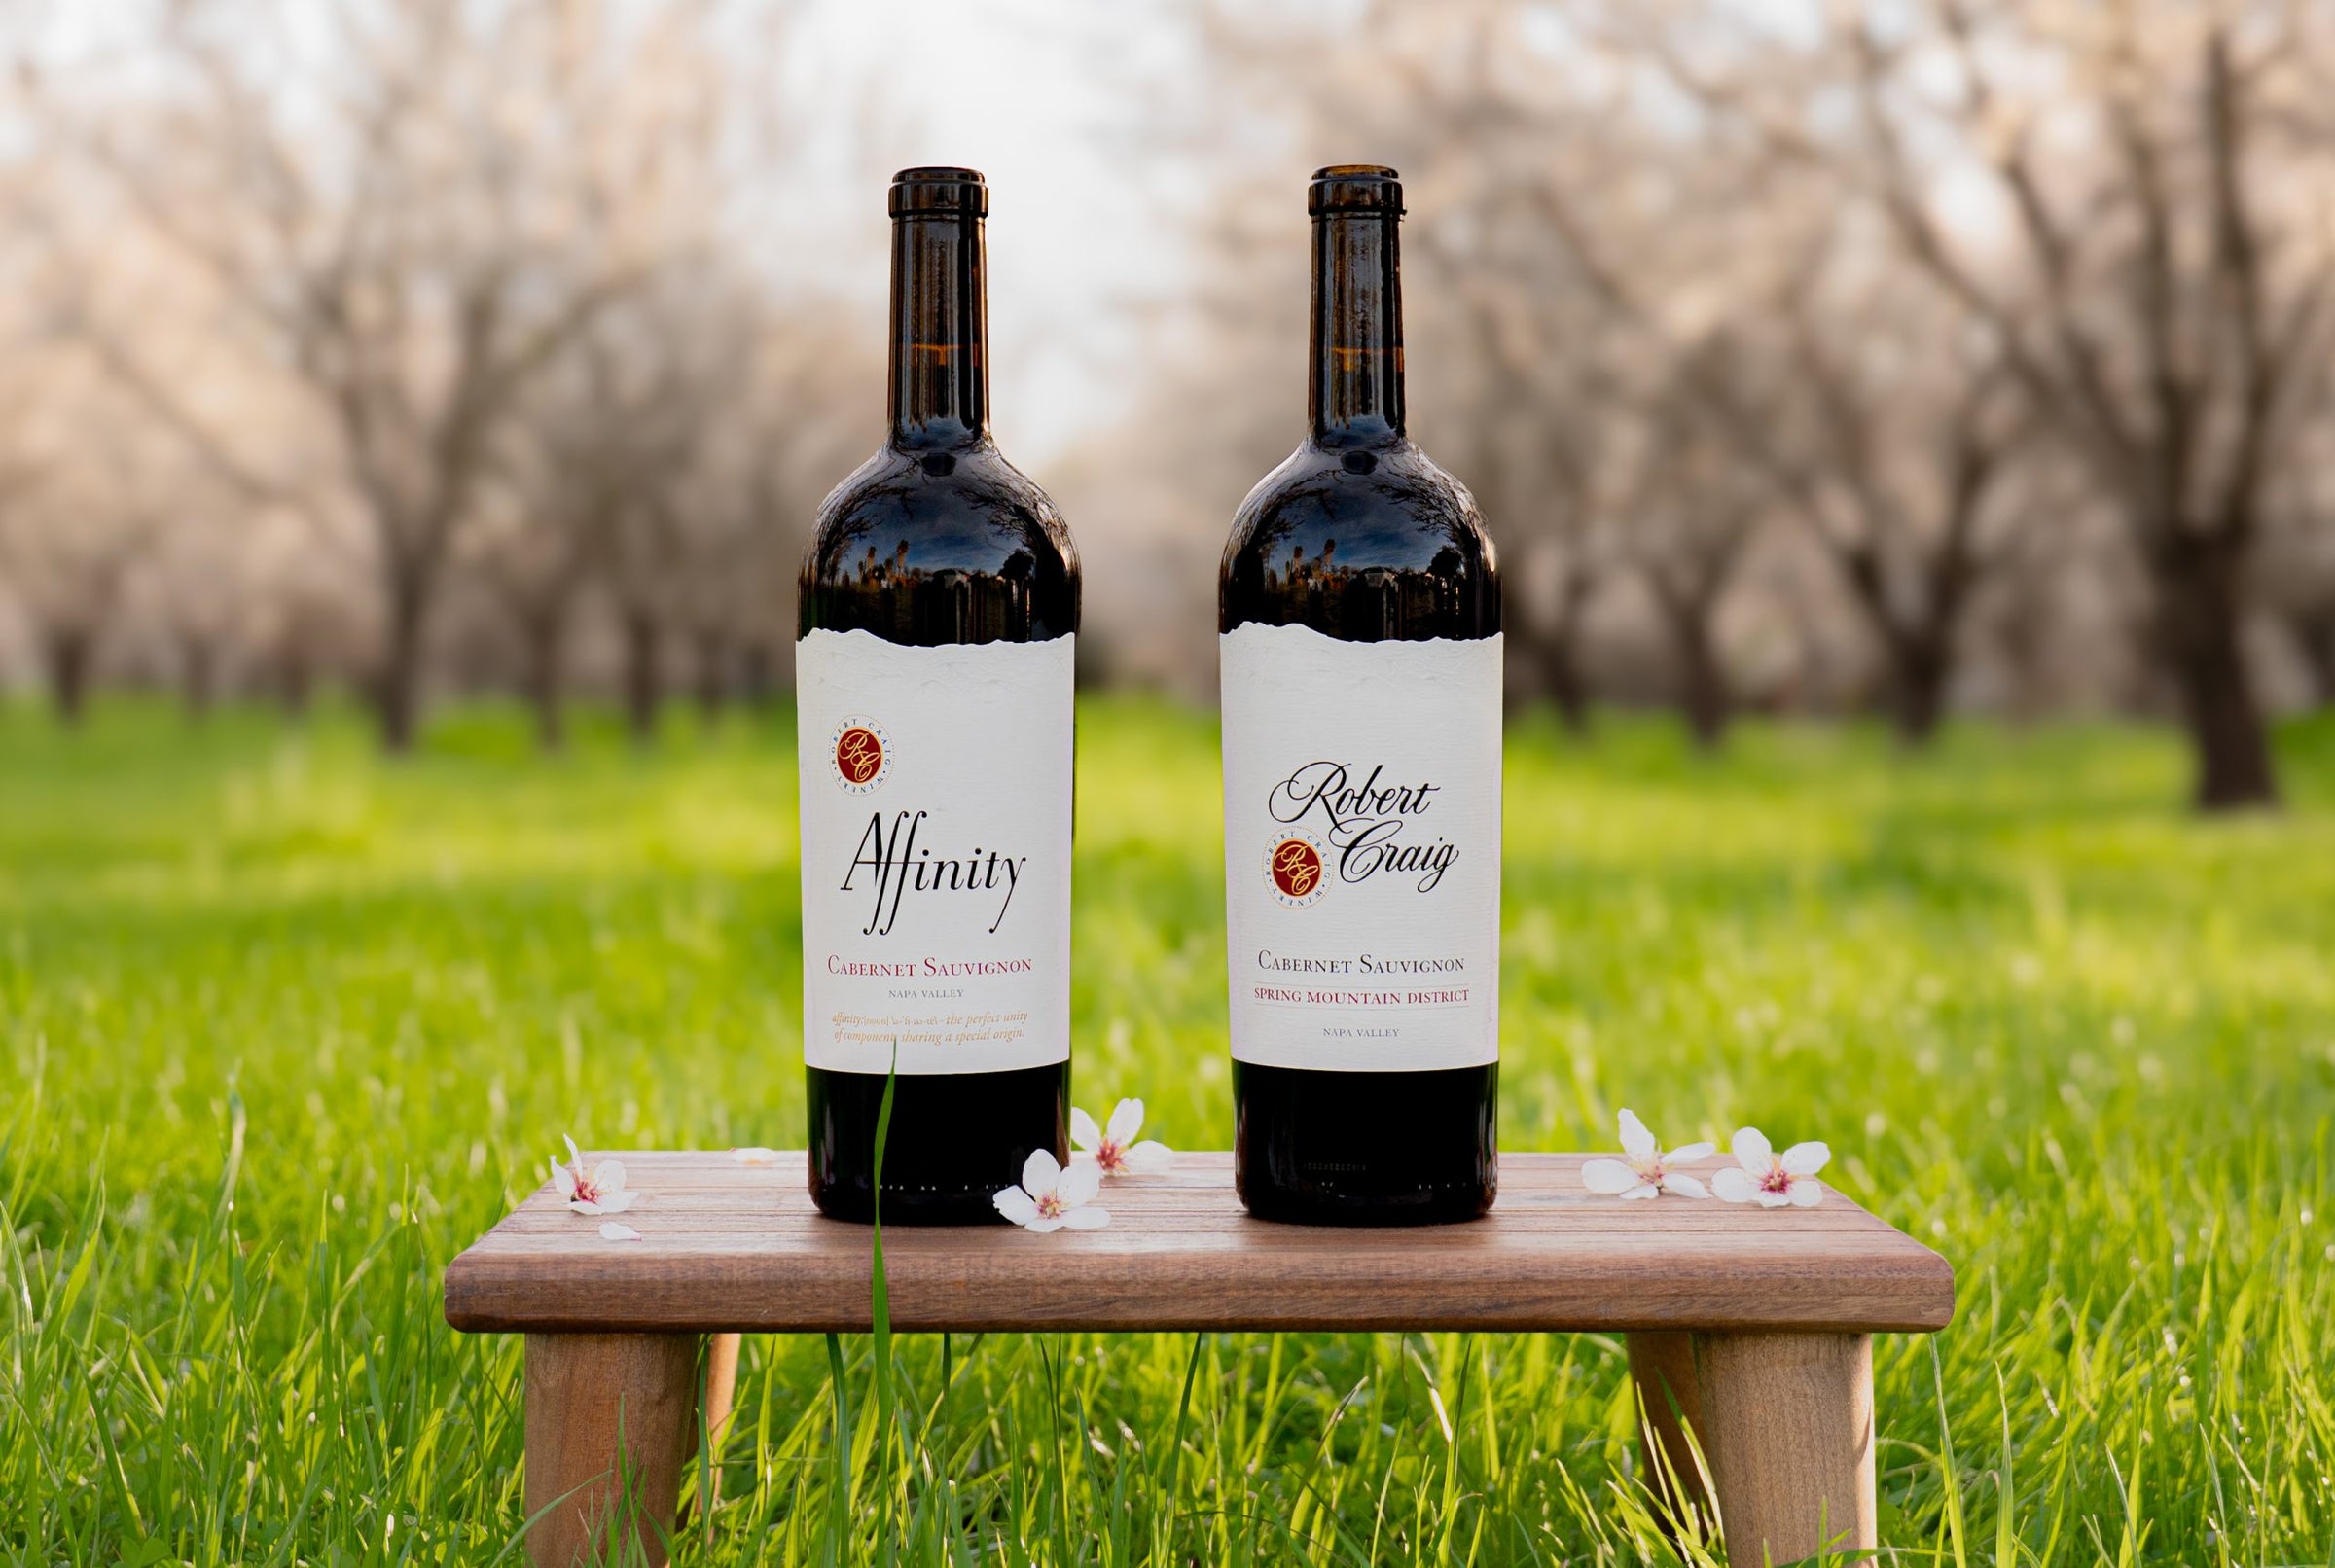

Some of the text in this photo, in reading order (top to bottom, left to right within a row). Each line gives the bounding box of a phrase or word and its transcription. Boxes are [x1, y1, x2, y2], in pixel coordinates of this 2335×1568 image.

[868, 722, 891, 766] CRAIG
[838, 776, 884, 794] WINERY
[1268, 761, 1441, 834] Robert
[1307, 835, 1331, 878] CRAIG
[1329, 817, 1459, 893] Craig
[840, 810, 1026, 935] Affinity
[1273, 888, 1323, 907] WINERY
[828, 954, 1032, 978] CABERNET SAUVIGNON
[1258, 949, 1464, 974] CABERNET SAUVIGNON
[888, 988, 964, 999] NAPA VALLEY
[1254, 987, 1470, 1005] SPRING MOUNTAIN DISTRICT
[946, 1014, 962, 1025] the
[965, 1012, 1000, 1028] perfect
[1003, 1011, 1027, 1024] unity
[834, 1028, 844, 1043] of
[901, 1029, 942, 1046] sharing
[945, 1033, 952, 1042] a
[955, 1028, 990, 1045] special
[1323, 1027, 1400, 1038] NAPA VALLEY
